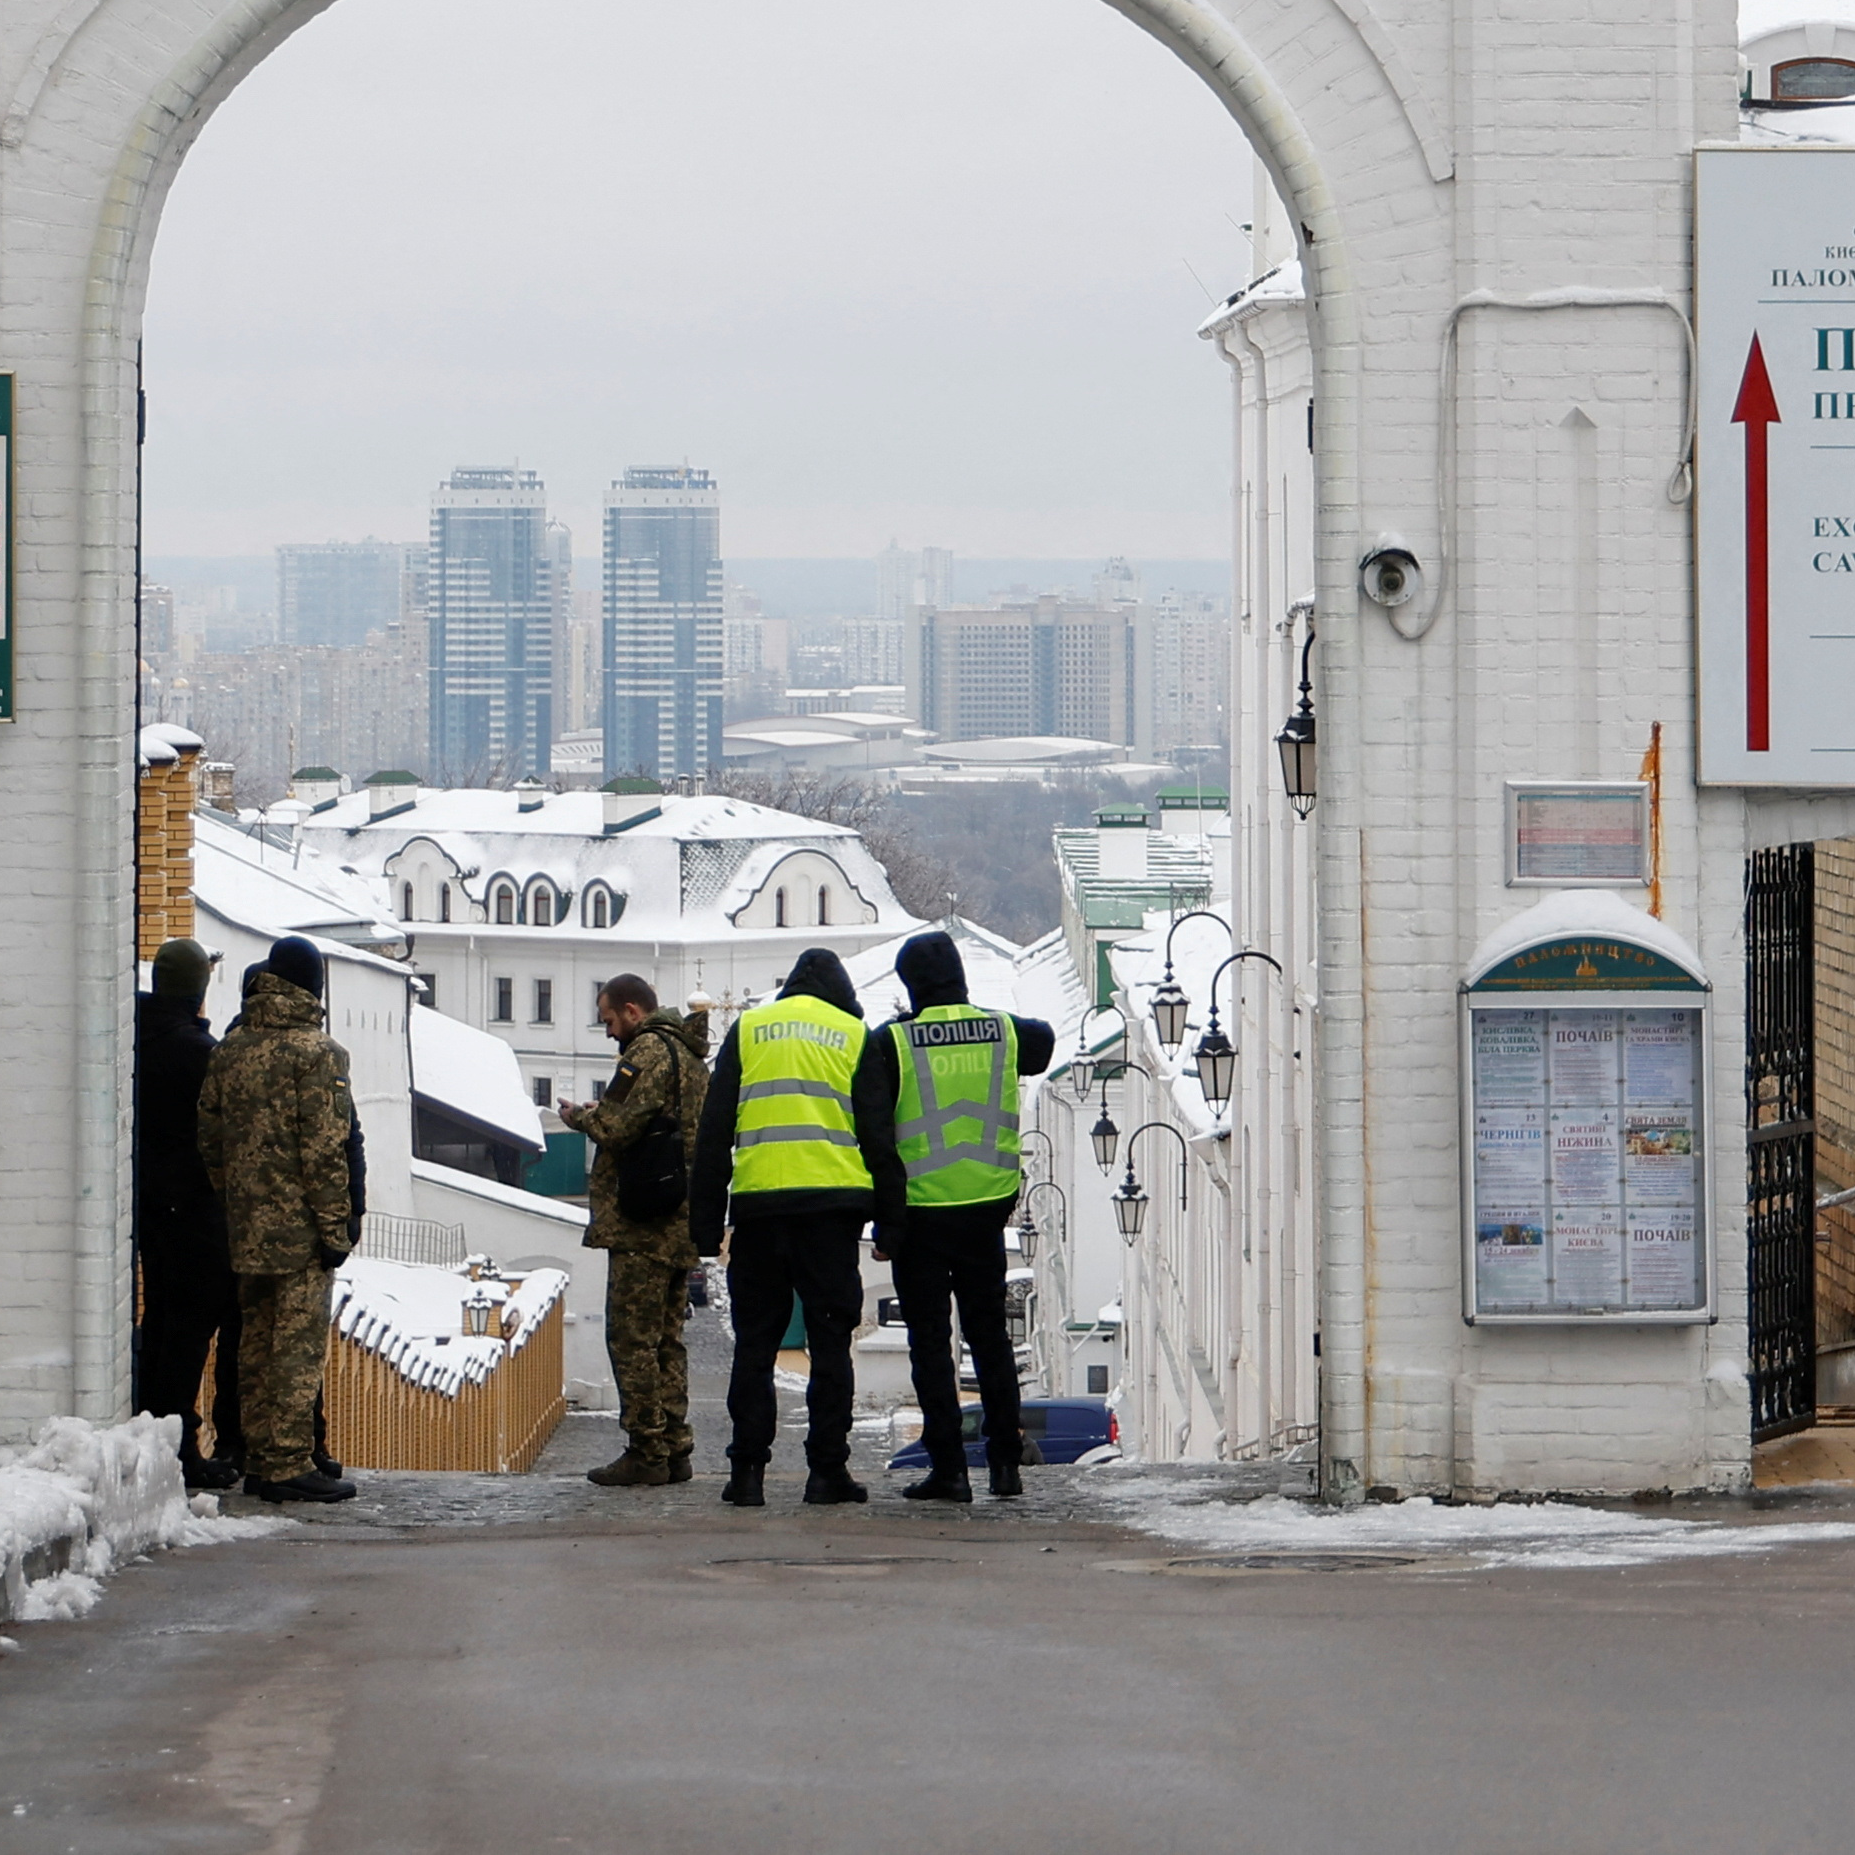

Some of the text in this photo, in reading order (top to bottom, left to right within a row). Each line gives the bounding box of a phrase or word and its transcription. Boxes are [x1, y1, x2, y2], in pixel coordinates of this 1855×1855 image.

[1523, 1012, 1534, 1021] 27
[1672, 1013, 1684, 1022] 10
[753, 1021, 848, 1050] ПОЛІЦІЯ
[913, 1020, 1000, 1045] ПОЛІЦІЯ
[1556, 1029, 1614, 1043] ПОЧАЇВ
[1603, 1113, 1610, 1122] 4
[1480, 1130, 1541, 1140] ЧЕРНІГІВ
[1557, 1137, 1613, 1148] НІЖИНА
[1601, 1213, 1611, 1221] 20
[1634, 1229, 1691, 1242] ПОЧАЇВ
[1567, 1238, 1604, 1247] КИЄВА
